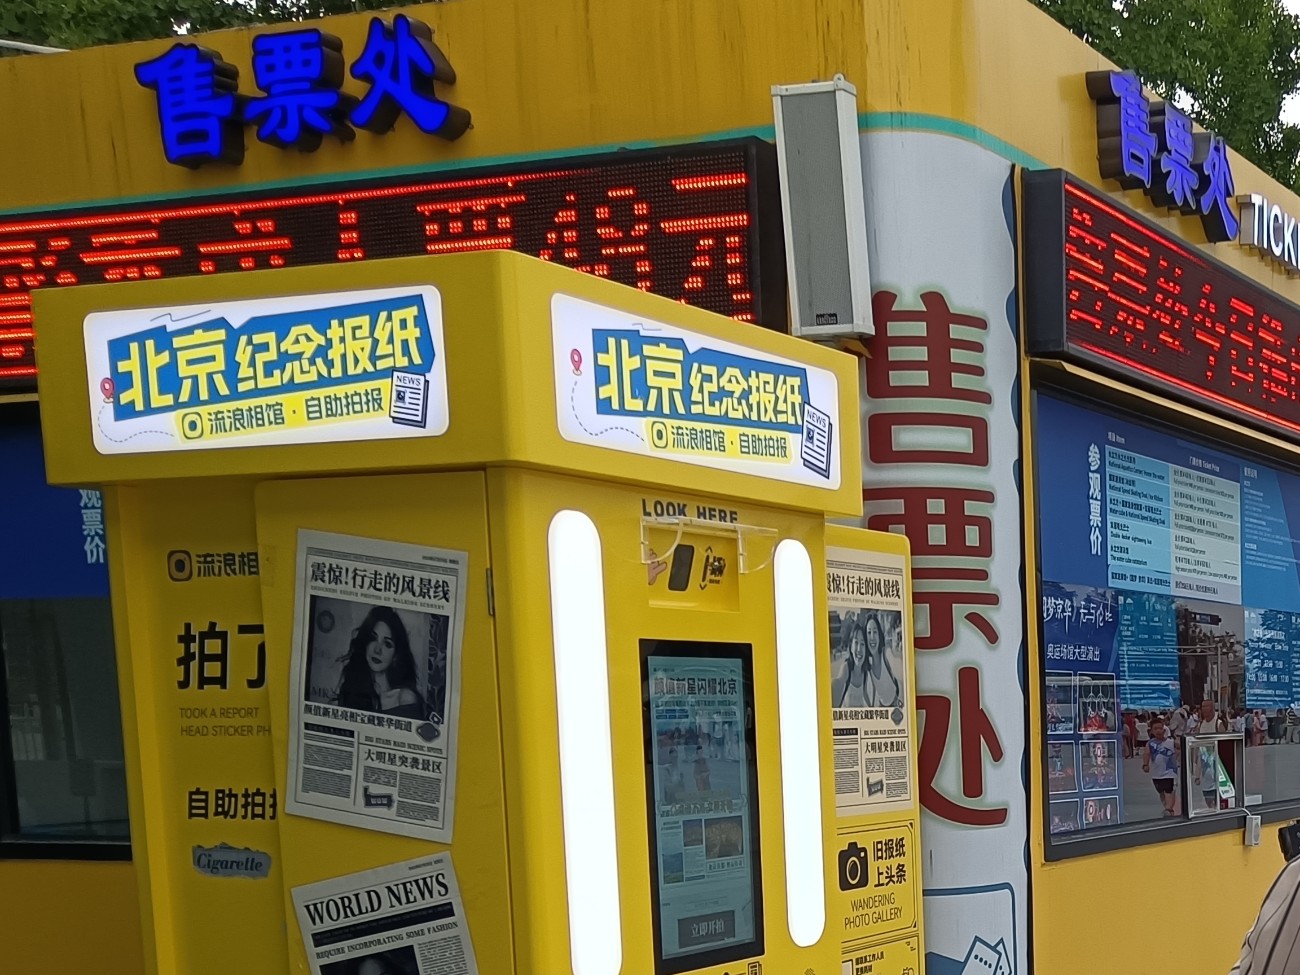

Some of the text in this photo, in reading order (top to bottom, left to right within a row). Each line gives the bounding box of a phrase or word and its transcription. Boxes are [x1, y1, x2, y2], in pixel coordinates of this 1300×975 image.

[134, 13, 449, 165] 售票处
[1109, 70, 1239, 242] 售票处
[116, 305, 423, 411] 北京纪念报纸
[396, 375, 422, 387] NEWS
[597, 337, 803, 425] 北京纪念报纸
[806, 409, 828, 428] NEWS
[641, 498, 739, 524] LOOK HERE
[1087, 442, 1102, 556] 参观票价
[195, 551, 260, 578] 流浪相
[867, 291, 1008, 827] 售票处
[310, 561, 450, 603] 震惊!行走的风景线
[1046, 643, 1100, 662] 奥运场馆大型演出
[179, 707, 260, 719] TOOK A REPORT
[180, 725, 209, 737] HEAD
[211, 725, 254, 737] STICKER
[364, 749, 442, 774] 大明星突袭景区
[196, 852, 264, 873] Cigarette
[872, 836, 906, 863] 旧报纸
[873, 863, 907, 889] 上头条
[304, 889, 382, 927] WORLD
[385, 872, 449, 909] NEWS
[850, 891, 896, 913] WANDERING
[844, 906, 903, 930] PHOTO GALLERY
[316, 921, 459, 960] REQUIRE INCORPORATING SOME FASHION
